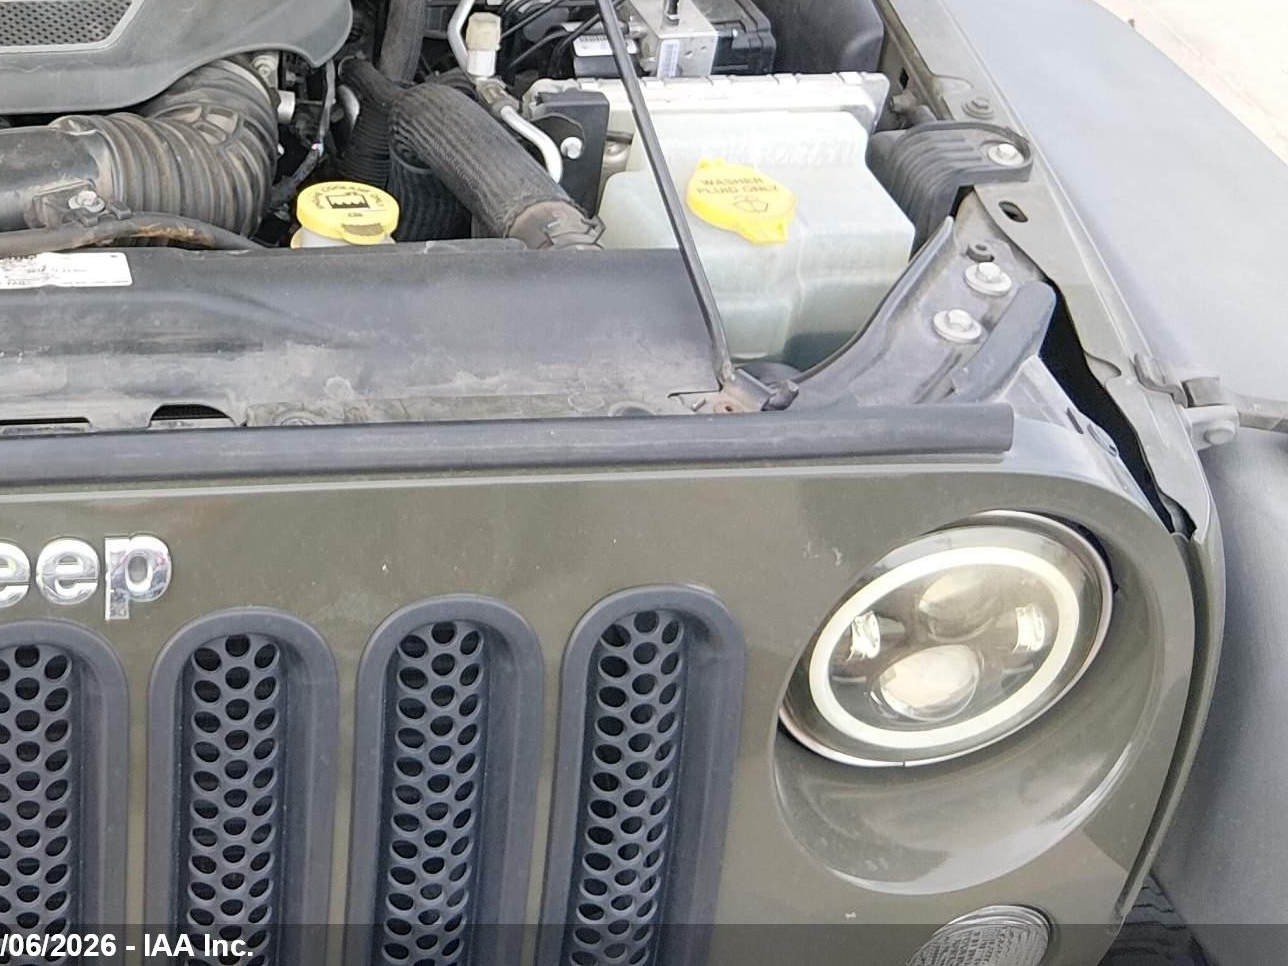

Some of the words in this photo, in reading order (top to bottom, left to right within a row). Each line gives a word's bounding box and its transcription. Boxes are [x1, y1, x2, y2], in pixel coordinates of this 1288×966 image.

[698, 177, 764, 186] WASHER
[696, 185, 739, 195] FLUID
[742, 185, 779, 193] ONLY
